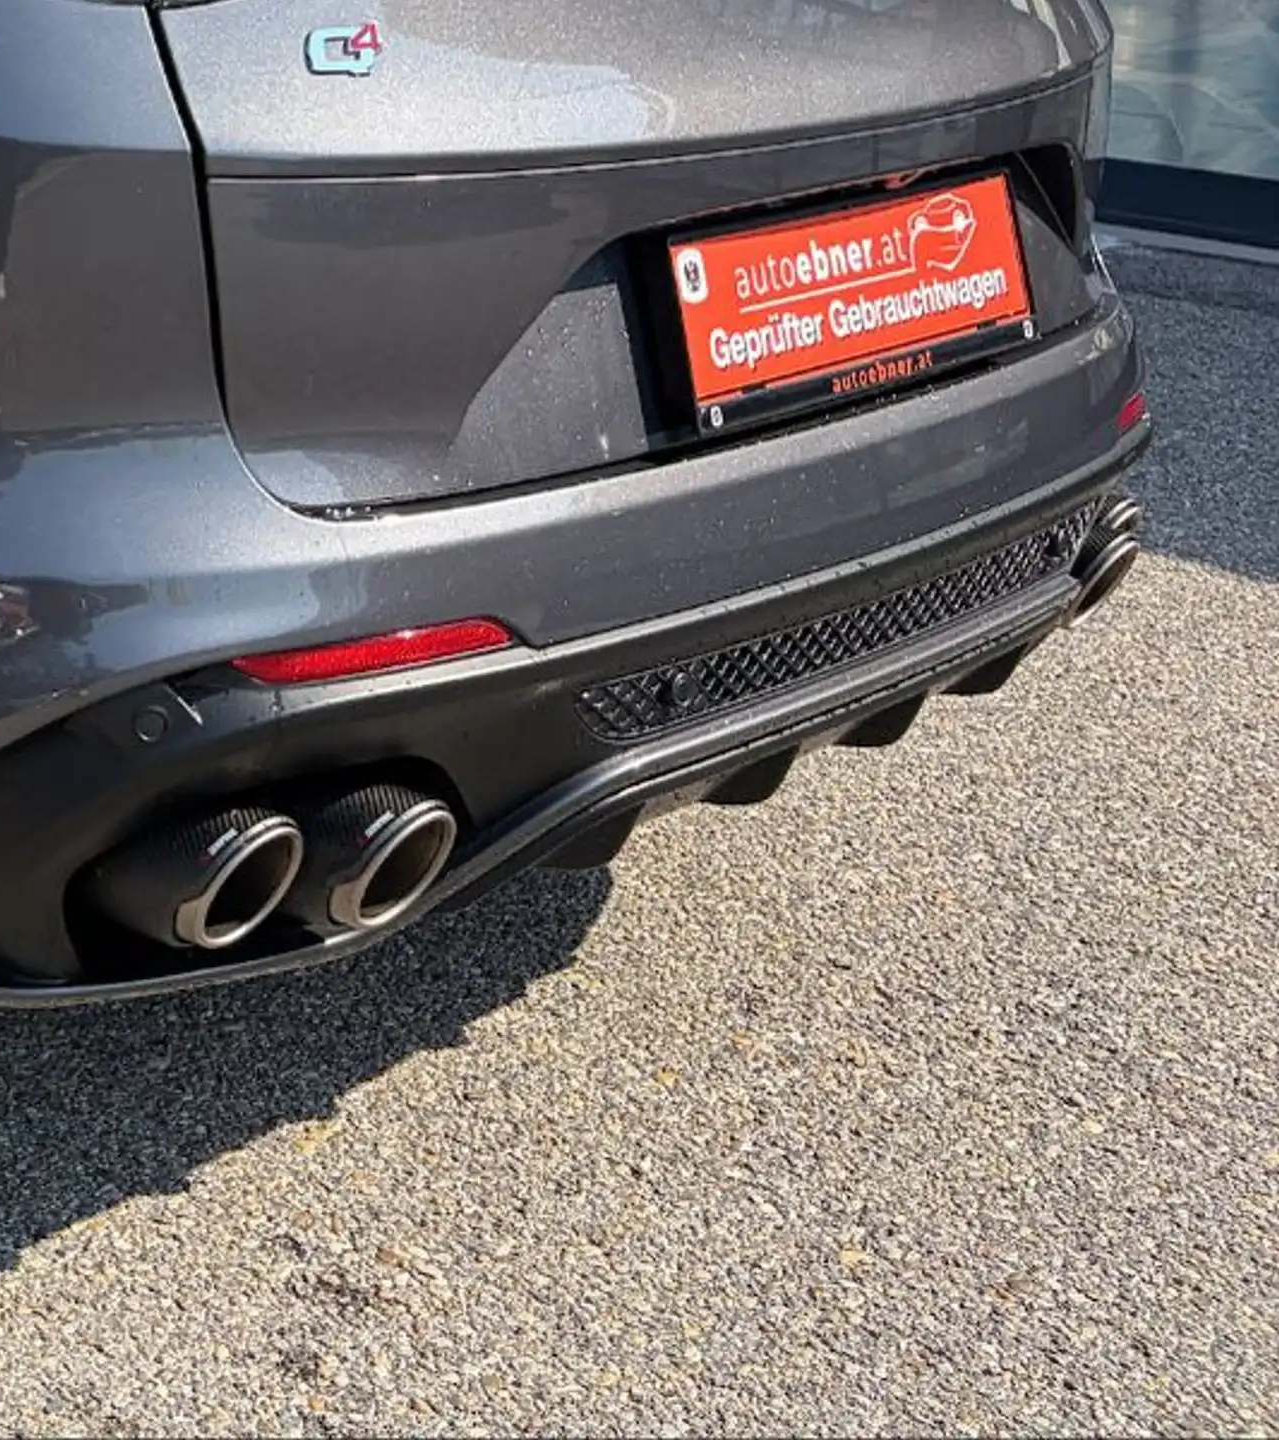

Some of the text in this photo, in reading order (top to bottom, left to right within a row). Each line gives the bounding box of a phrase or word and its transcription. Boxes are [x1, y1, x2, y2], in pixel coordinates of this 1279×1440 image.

[304, 20, 382, 78] Q4
[733, 227, 907, 300] autoebner.at
[709, 267, 1007, 369] Geprüfter Gebrauchtwagen
[831, 349, 934, 394] autoebner.at
